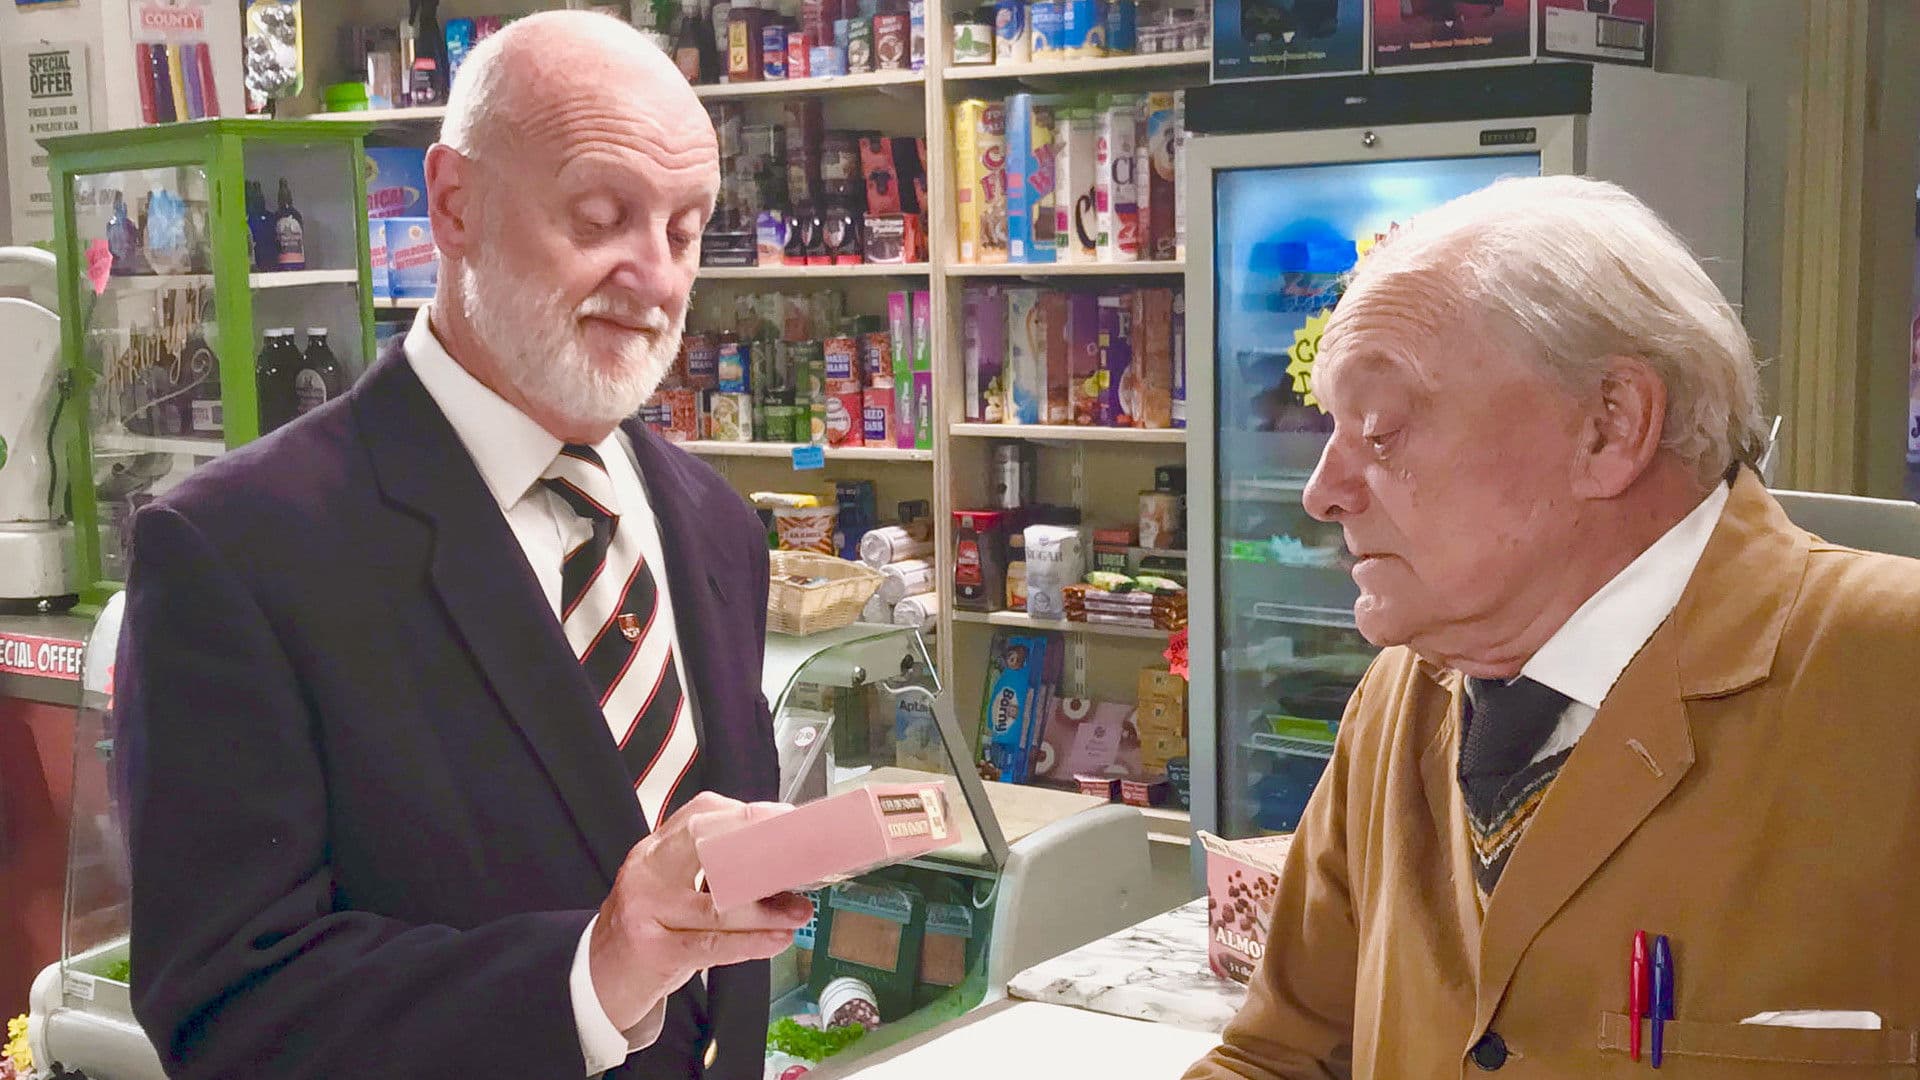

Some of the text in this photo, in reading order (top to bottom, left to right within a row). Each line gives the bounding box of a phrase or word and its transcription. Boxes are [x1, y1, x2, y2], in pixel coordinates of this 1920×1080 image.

[145, 13, 200, 29] COUNTY
[29, 55, 71, 74] SPECIAL
[30, 72, 72, 94] OFFER
[1027, 550, 1063, 562] SUGAR
[0, 640, 35, 668] ECIAL
[995, 688, 1015, 732] Barny
[1216, 926, 1266, 958] ALMO
